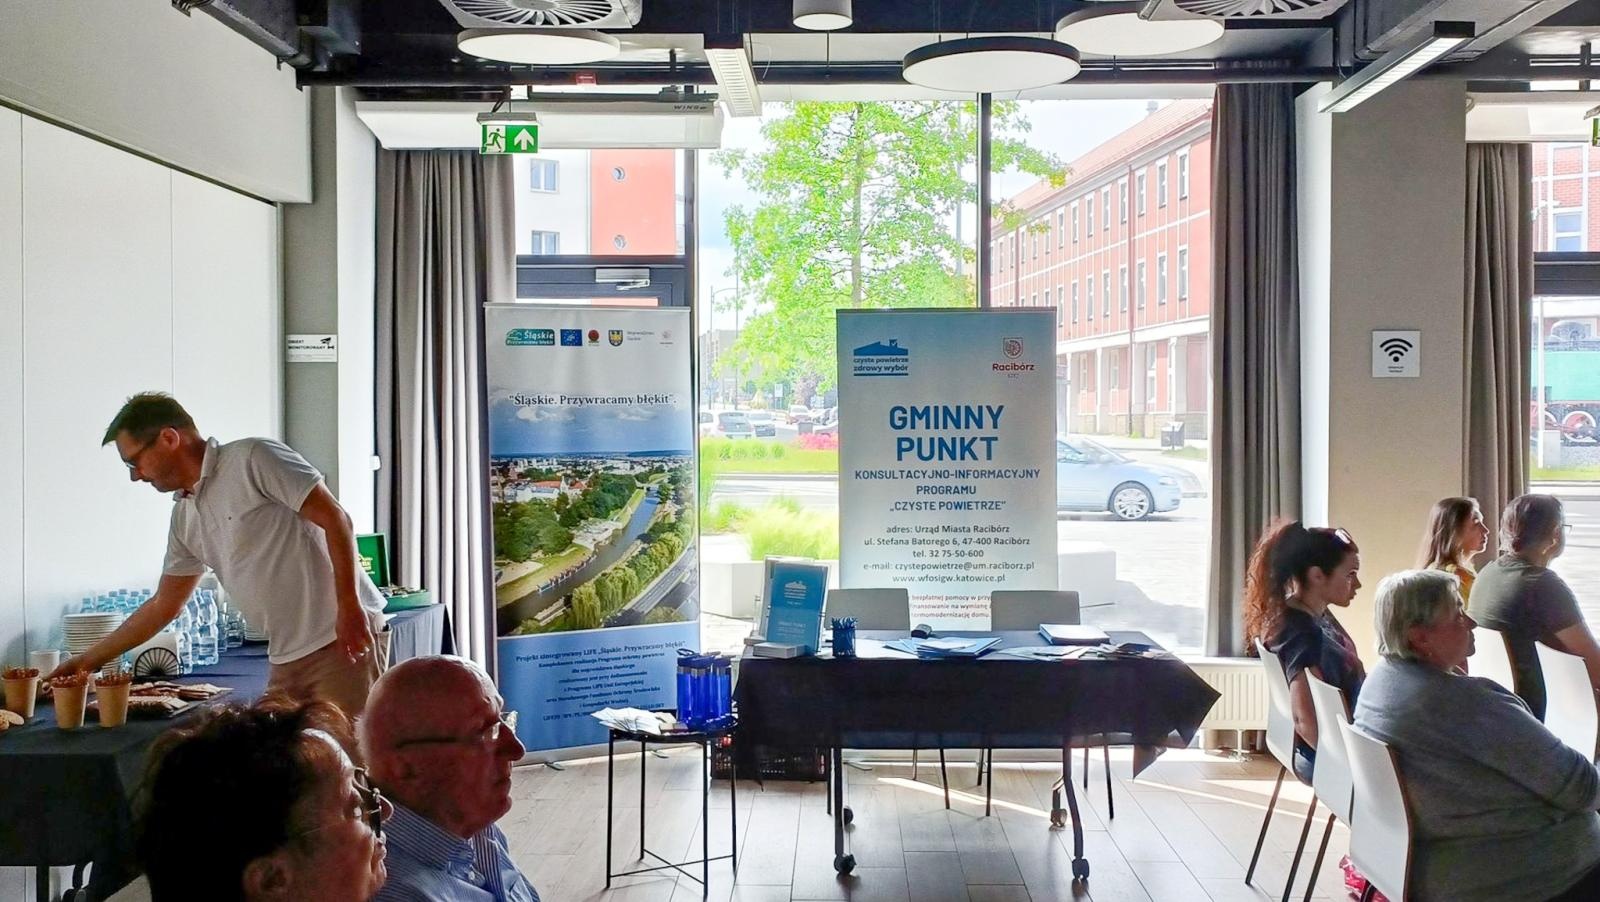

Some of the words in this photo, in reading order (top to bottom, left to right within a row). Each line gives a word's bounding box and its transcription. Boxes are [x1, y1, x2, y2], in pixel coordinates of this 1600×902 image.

[884, 364, 908, 372] wybór
[992, 362, 1034, 371] Racibórz
[560, 395, 634, 408] Przywracamy
[889, 405, 1005, 430] GMINNY
[897, 437, 998, 461] PUNKT
[855, 469, 1040, 480] KONSULTACYJNO-INFORMACYJNY
[916, 486, 977, 494] PROGRAMU
[915, 525, 940, 534] Urząd
[942, 525, 971, 533] Miasta
[974, 524, 1010, 532] Racibórz
[877, 538, 910, 546] Stefana
[912, 538, 950, 548] Batorego
[952, 538, 960, 546] 6,
[962, 537, 992, 545] 47-400
[895, 562, 1034, 572] czystepowietrze@um.raciborz.pl
[892, 574, 1006, 584] www.wfosigw.katowice.pl
